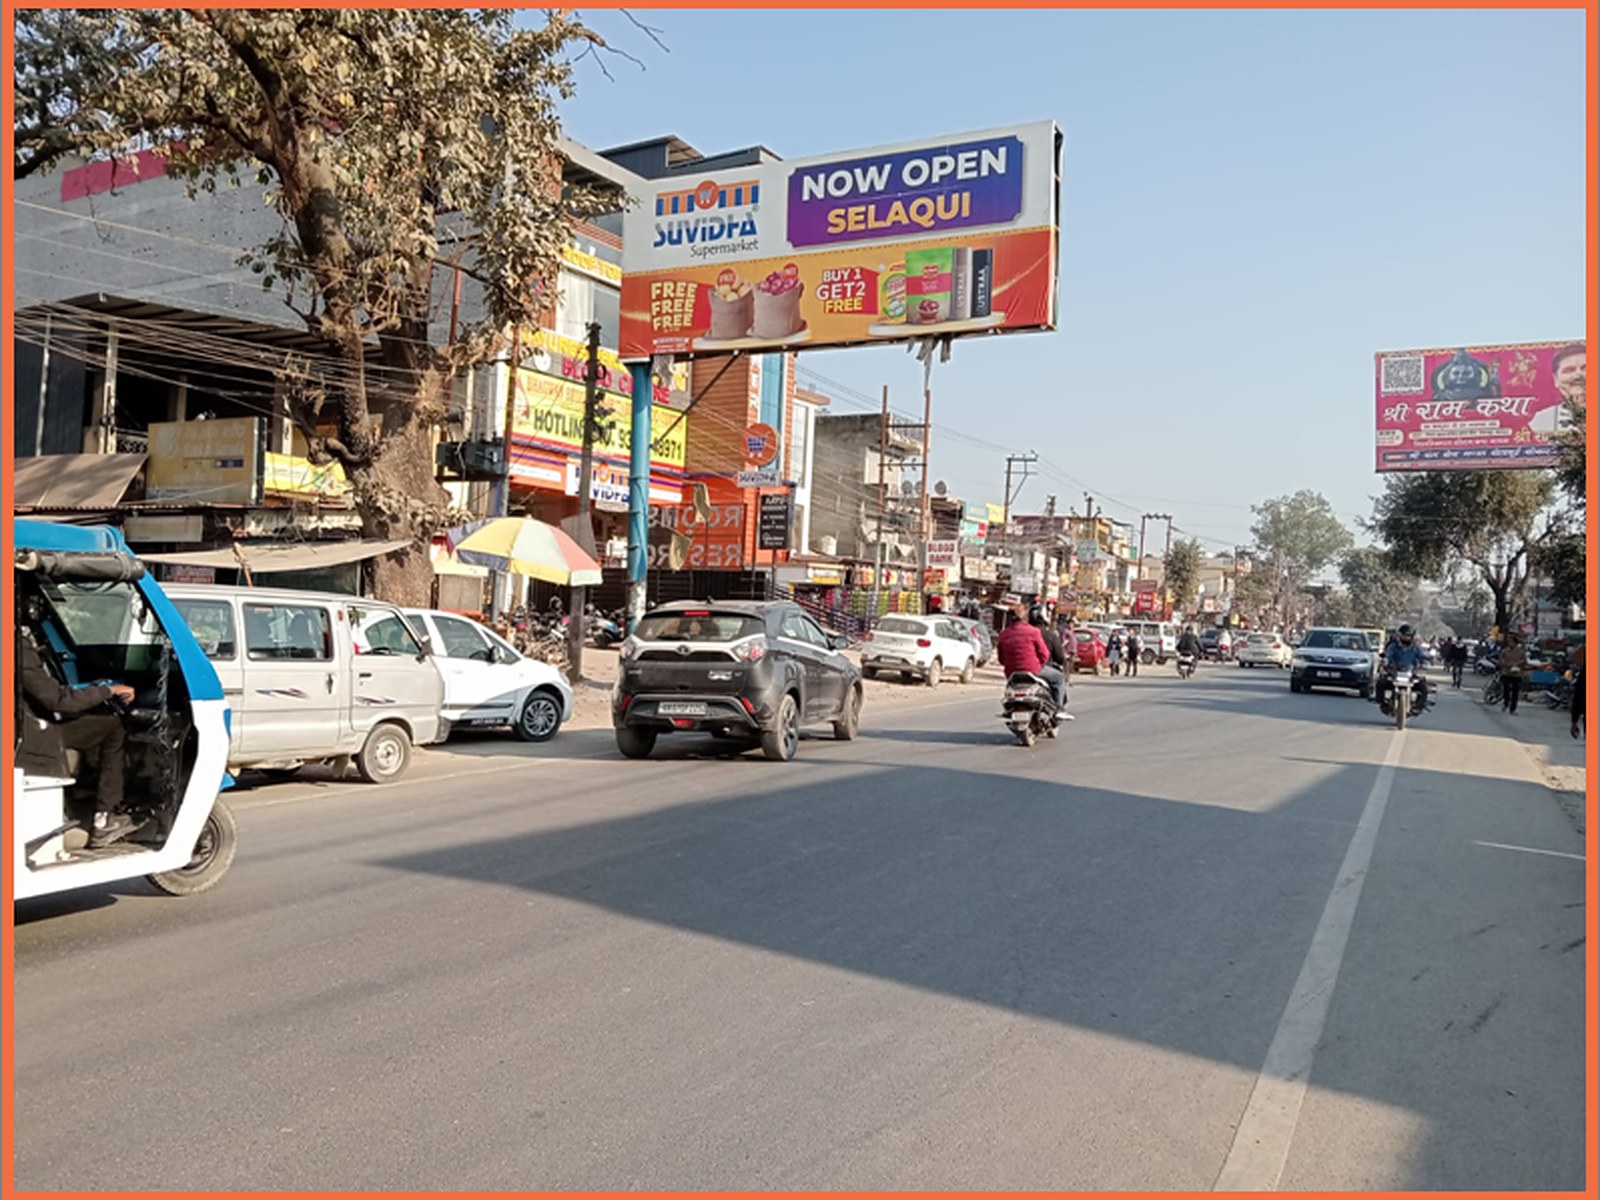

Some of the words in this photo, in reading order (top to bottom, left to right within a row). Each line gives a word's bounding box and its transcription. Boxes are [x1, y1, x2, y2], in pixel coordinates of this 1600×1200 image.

[802, 163, 892, 201] NOW
[902, 146, 1007, 186] OPEN
[827, 192, 970, 234] SELAQUI
[690, 238, 759, 258] Supermarket
[823, 267, 850, 282] BUY
[853, 267, 862, 279] 1
[651, 281, 698, 299] FREE
[652, 299, 694, 316] FREE
[825, 297, 863, 313] FREE
[653, 314, 692, 331] FREE
[1383, 403, 1412, 422] श्री
[1415, 401, 1467, 420] राम
[1476, 397, 1536, 416] कथा
[927, 543, 955, 553] BLOOD
[929, 553, 954, 564] BANK
